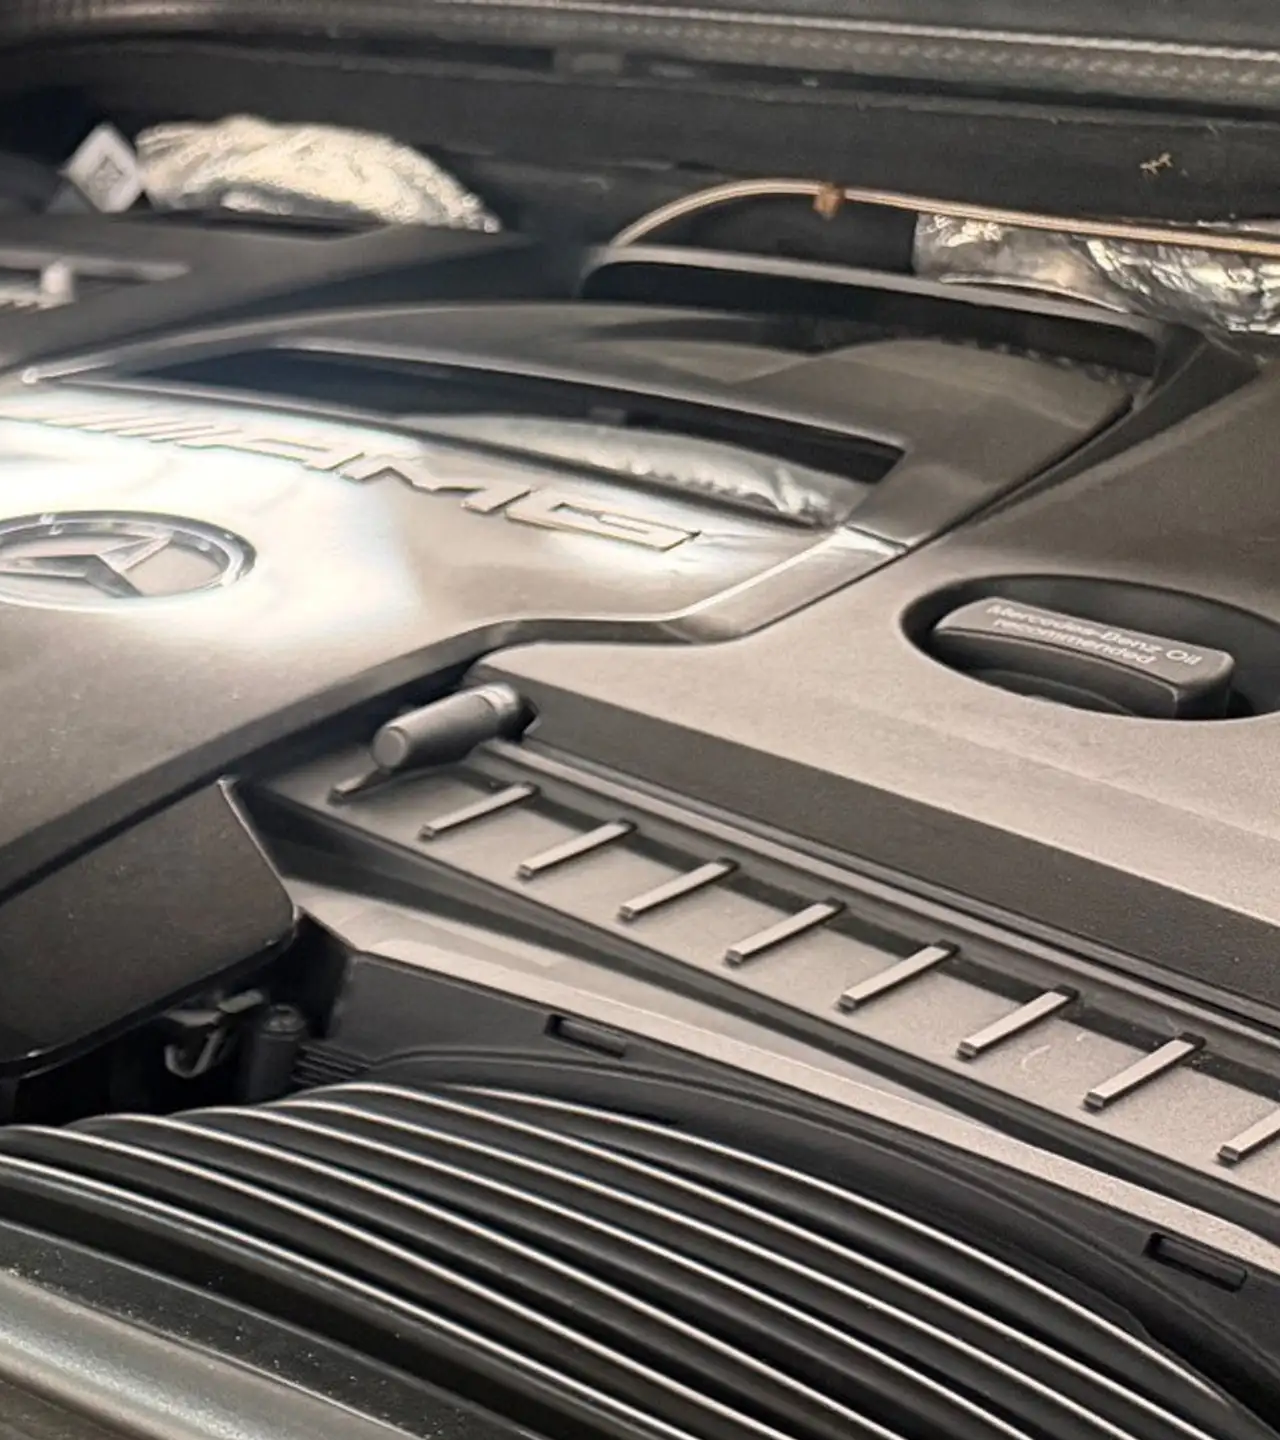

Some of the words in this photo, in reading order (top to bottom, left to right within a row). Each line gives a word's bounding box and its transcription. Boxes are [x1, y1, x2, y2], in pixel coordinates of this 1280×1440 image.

[165, 426, 703, 553] AMG
[986, 604, 1163, 653] Mercedes-Benz
[1165, 649, 1203, 666] Oil
[993, 617, 1157, 665] recommended
